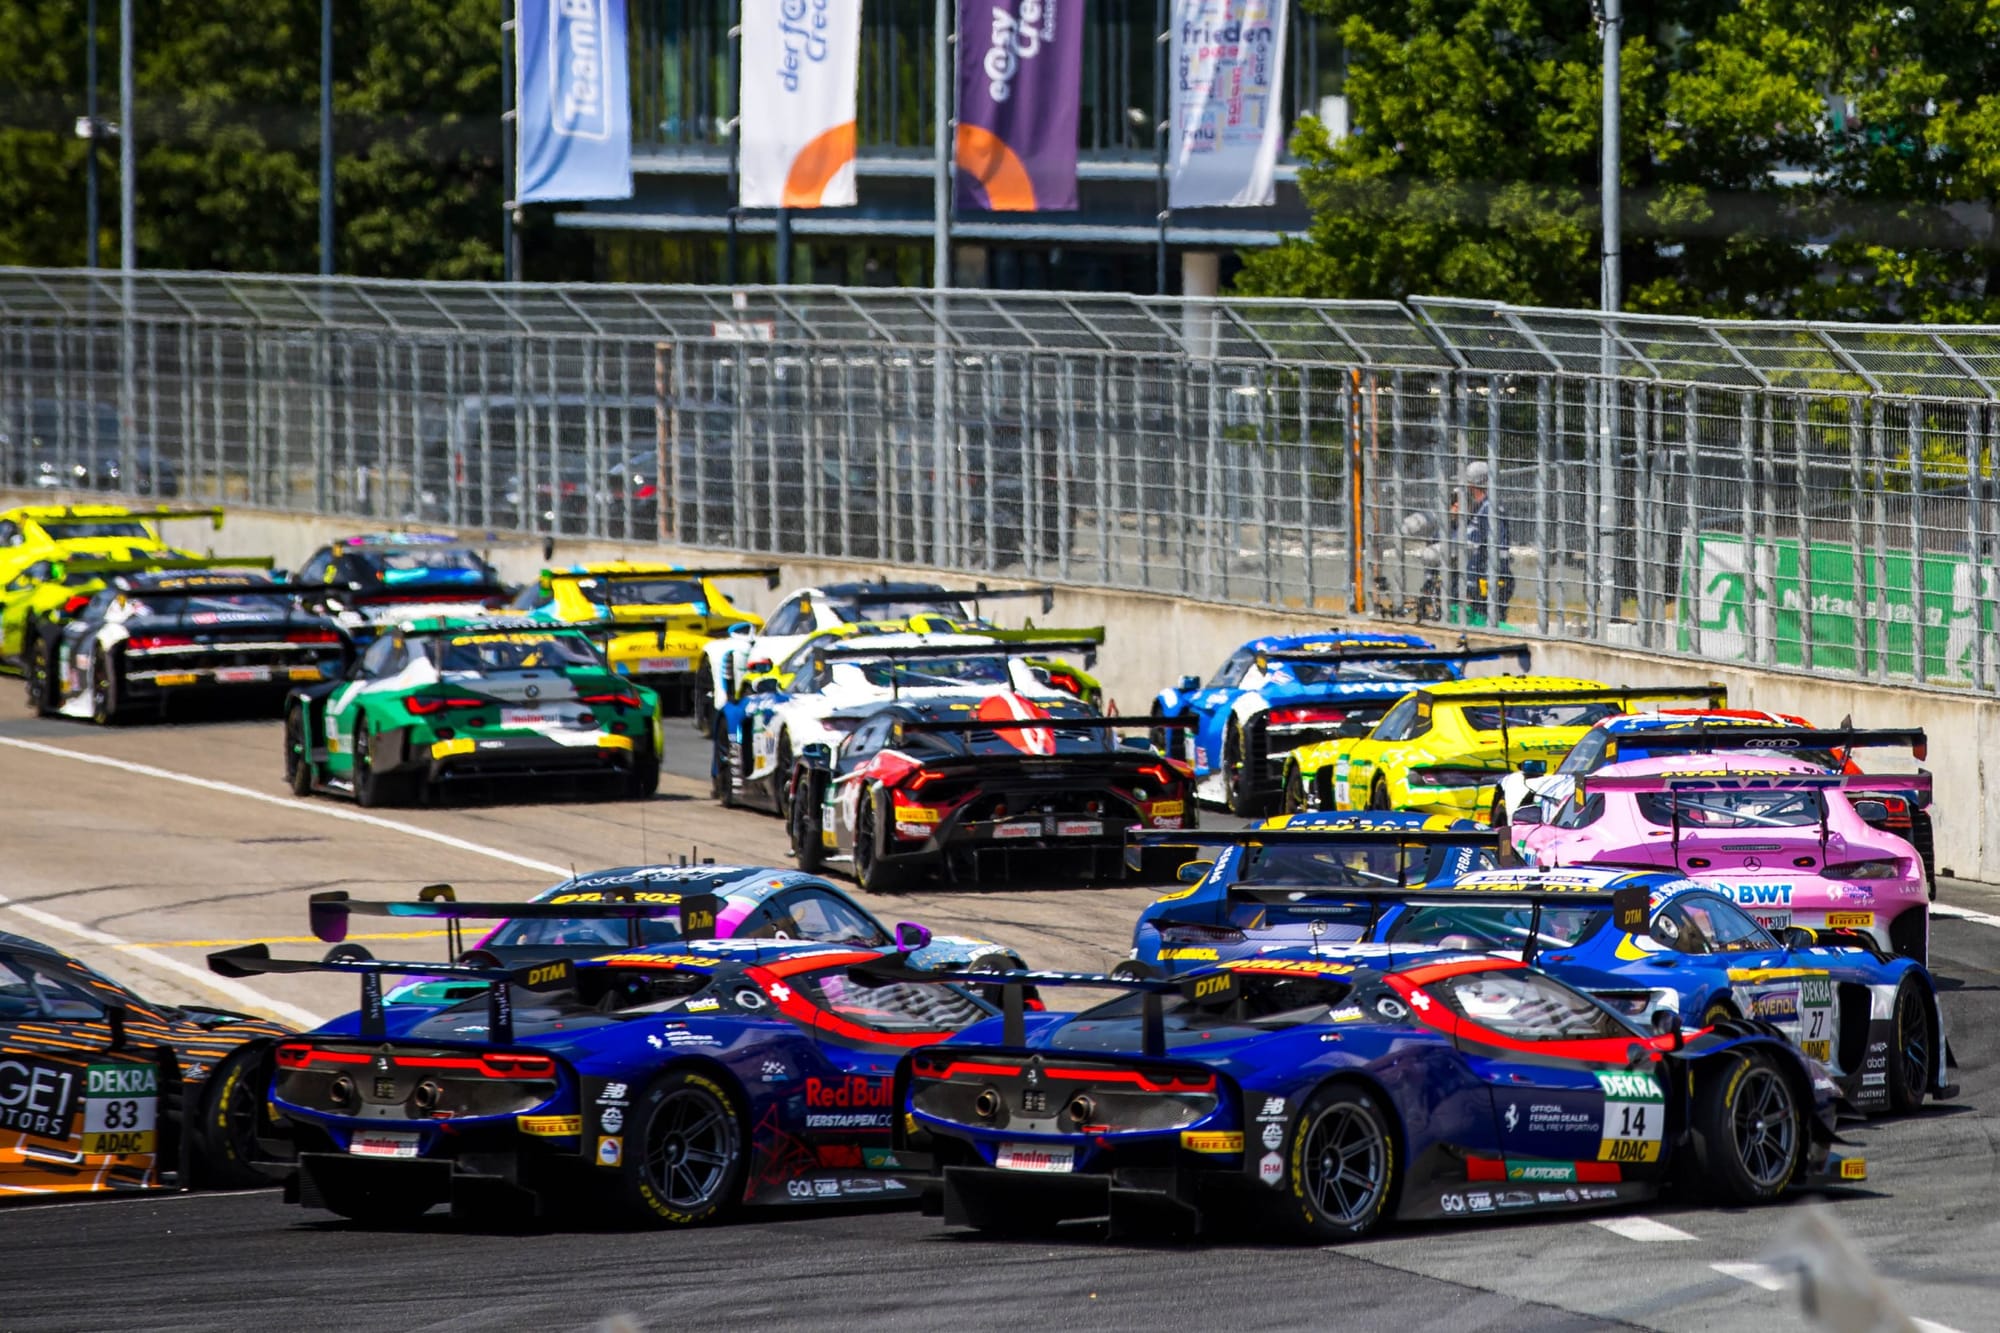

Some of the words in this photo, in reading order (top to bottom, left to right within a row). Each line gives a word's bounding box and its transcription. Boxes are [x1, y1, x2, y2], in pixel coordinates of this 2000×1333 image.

[1011, 0, 1040, 58] Cre
[1183, 20, 1272, 44] frieden
[562, 0, 599, 121] TeamB
[776, 41, 798, 93] der
[1783, 588, 1943, 627] Ntasag
[634, 892, 683, 904] 202
[1739, 885, 1792, 903] BWT
[1624, 909, 1642, 924] DTM
[1753, 914, 1791, 929] orsport
[1828, 914, 1871, 925] PIRELLI
[528, 963, 566, 985] DTM
[1195, 974, 1231, 998] DTM
[1803, 981, 1831, 1002] DEKRA
[1809, 1011, 1824, 1039] 27
[1807, 1041, 1826, 1060] ADAC
[88, 1067, 157, 1093] DEKRA
[1600, 1072, 1663, 1098] DEKRA
[806, 1077, 849, 1107] Red
[853, 1077, 893, 1107] Bull
[104, 1101, 139, 1129] 83
[1530, 1105, 1562, 1113] OFFICIAL
[1530, 1114, 1560, 1122] FERRARI
[1561, 1114, 1589, 1122] DEALER
[523, 1119, 579, 1132] PIRELLI
[1620, 1107, 1646, 1136] 14
[95, 1132, 143, 1154] ADAC
[1187, 1136, 1242, 1149] PIRELLI
[1609, 1140, 1649, 1161] ADAC
[1441, 1194, 1467, 1211] GO!
